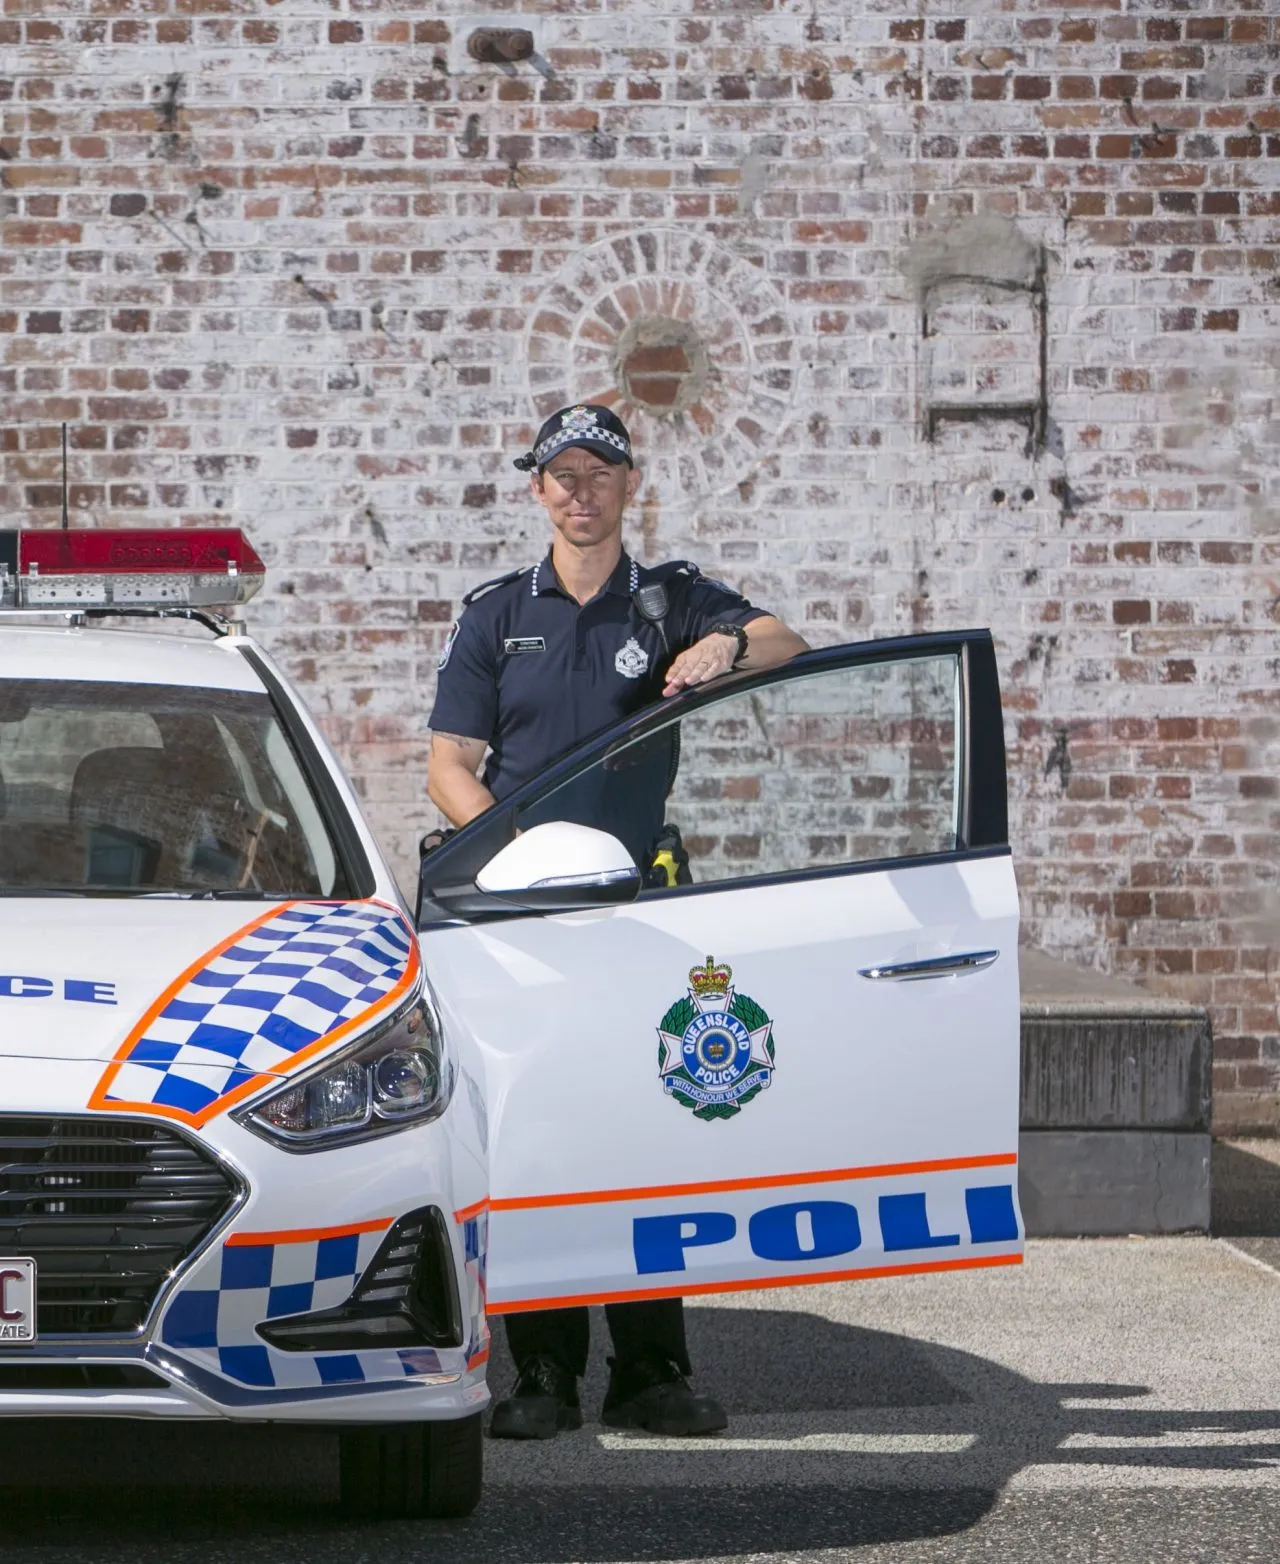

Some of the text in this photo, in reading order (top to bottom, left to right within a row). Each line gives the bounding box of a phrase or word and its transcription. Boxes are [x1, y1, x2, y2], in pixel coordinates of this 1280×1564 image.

[684, 1013, 750, 1054] QUEENSLAND
[672, 1074, 762, 1100] WITH HONOUR WE SERVE
[695, 1065, 740, 1083] POLICE
[633, 1184, 1019, 1275] POLI
